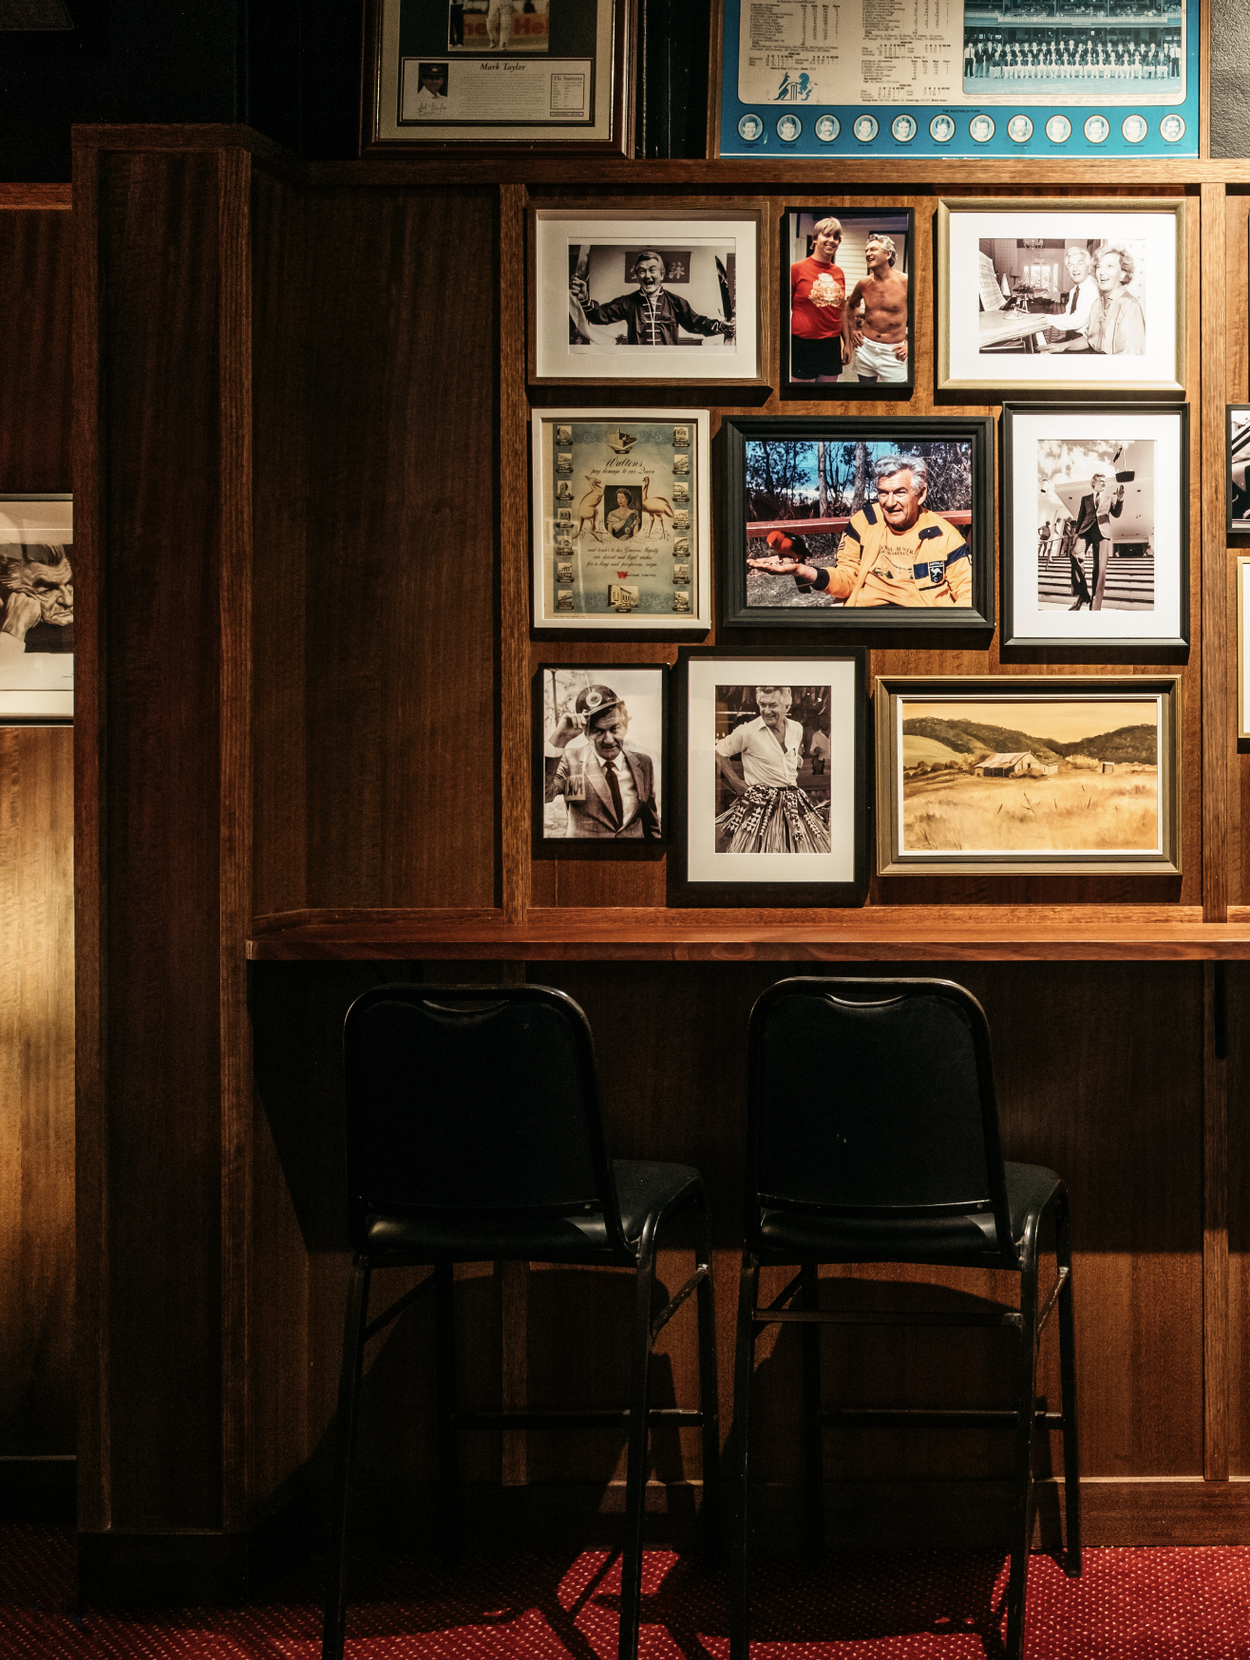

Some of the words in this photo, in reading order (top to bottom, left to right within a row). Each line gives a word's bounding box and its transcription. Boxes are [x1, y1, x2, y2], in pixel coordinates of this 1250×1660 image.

[480, 63, 500, 71] Mark
[503, 63, 526, 72] Taylor
[605, 457, 643, 467] Waltons
[590, 468, 601, 476] pay
